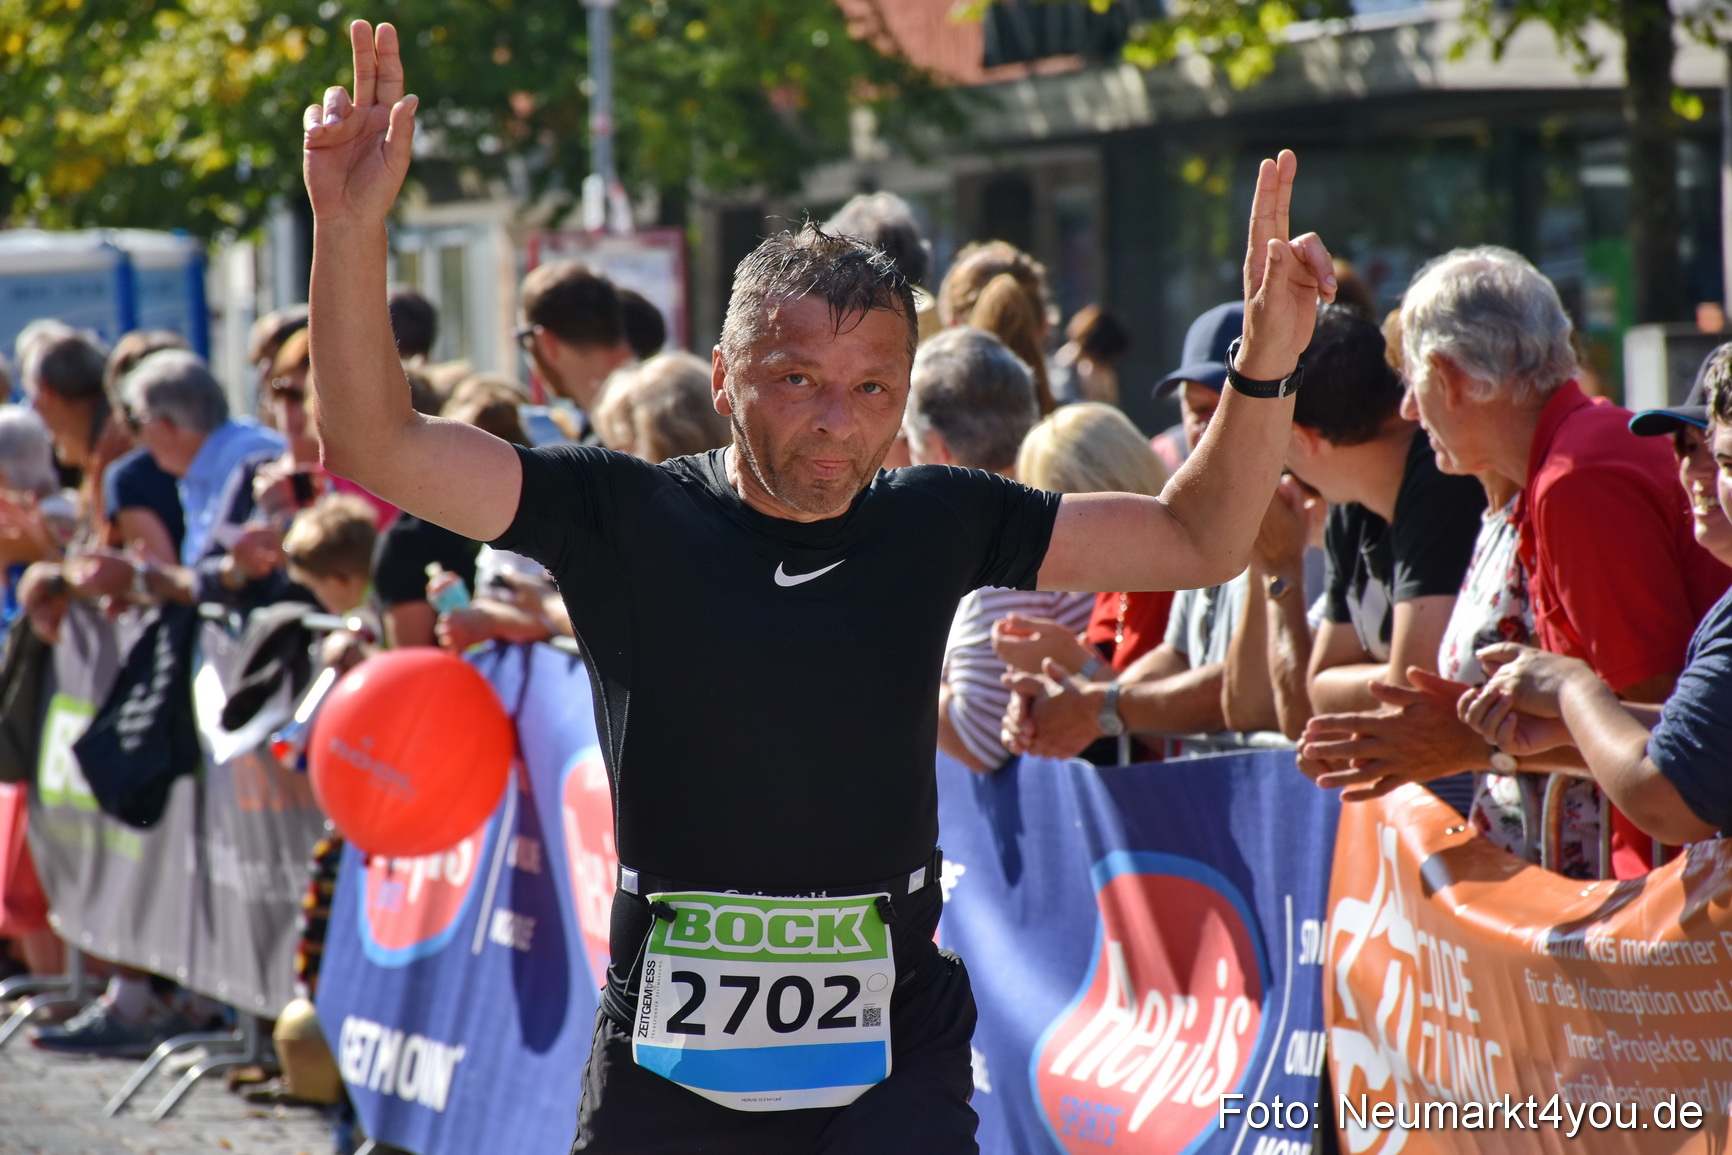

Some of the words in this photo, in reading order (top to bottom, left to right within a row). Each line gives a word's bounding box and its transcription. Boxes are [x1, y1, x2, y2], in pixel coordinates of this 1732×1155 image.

[667, 904, 870, 953] BOCK
[1620, 930, 1718, 966] moderner
[666, 971, 861, 1035] 2702
[1552, 972, 1579, 1009] die
[1576, 977, 1684, 1026] Konzeption
[1684, 978, 1732, 1014] und
[1563, 1022, 1605, 1061] Ihrer
[1606, 1029, 1701, 1073] Projekte
